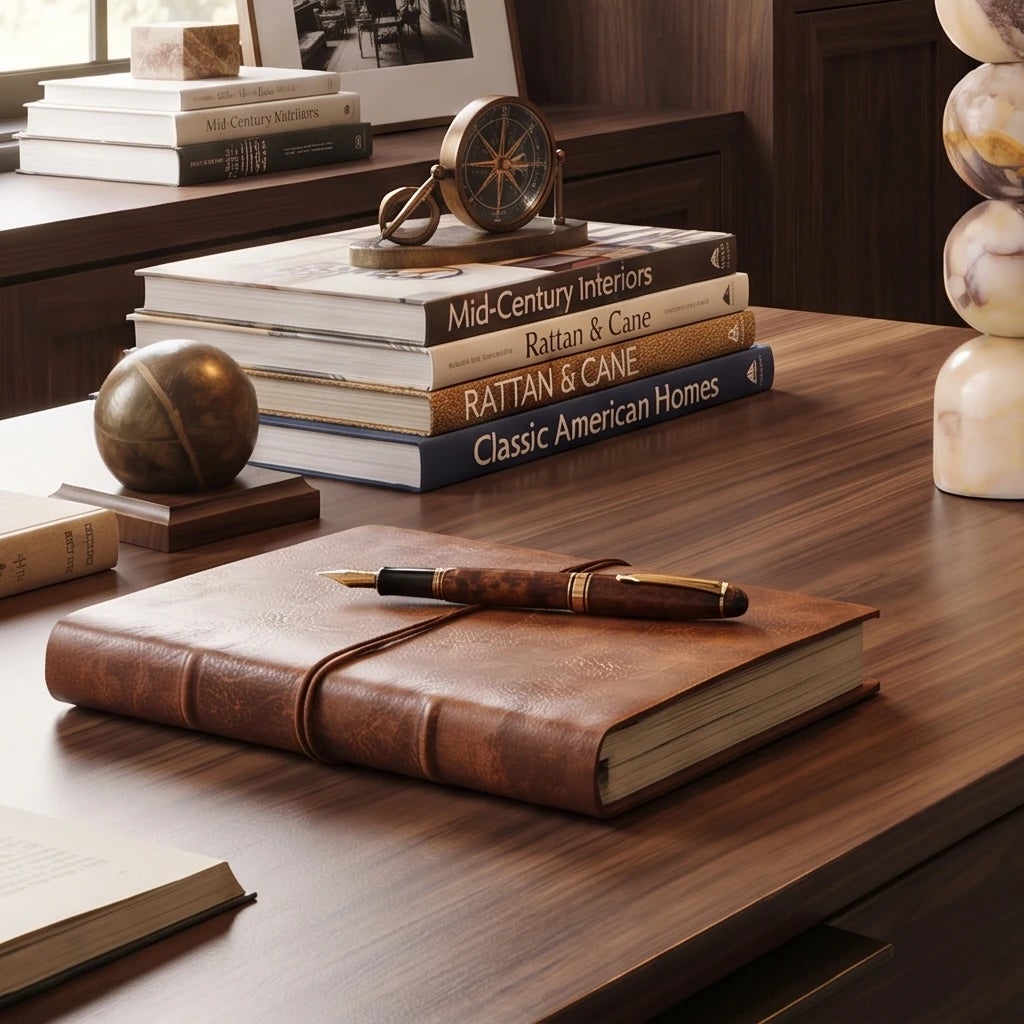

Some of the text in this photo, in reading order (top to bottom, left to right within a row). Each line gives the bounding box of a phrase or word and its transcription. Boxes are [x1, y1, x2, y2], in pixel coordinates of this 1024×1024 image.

[447, 265, 653, 332] Mid-Century Interiors
[525, 309, 652, 358] Rattan & Cane
[464, 346, 640, 421] RATTAN & CANE
[473, 376, 720, 466] Classic American Homes
